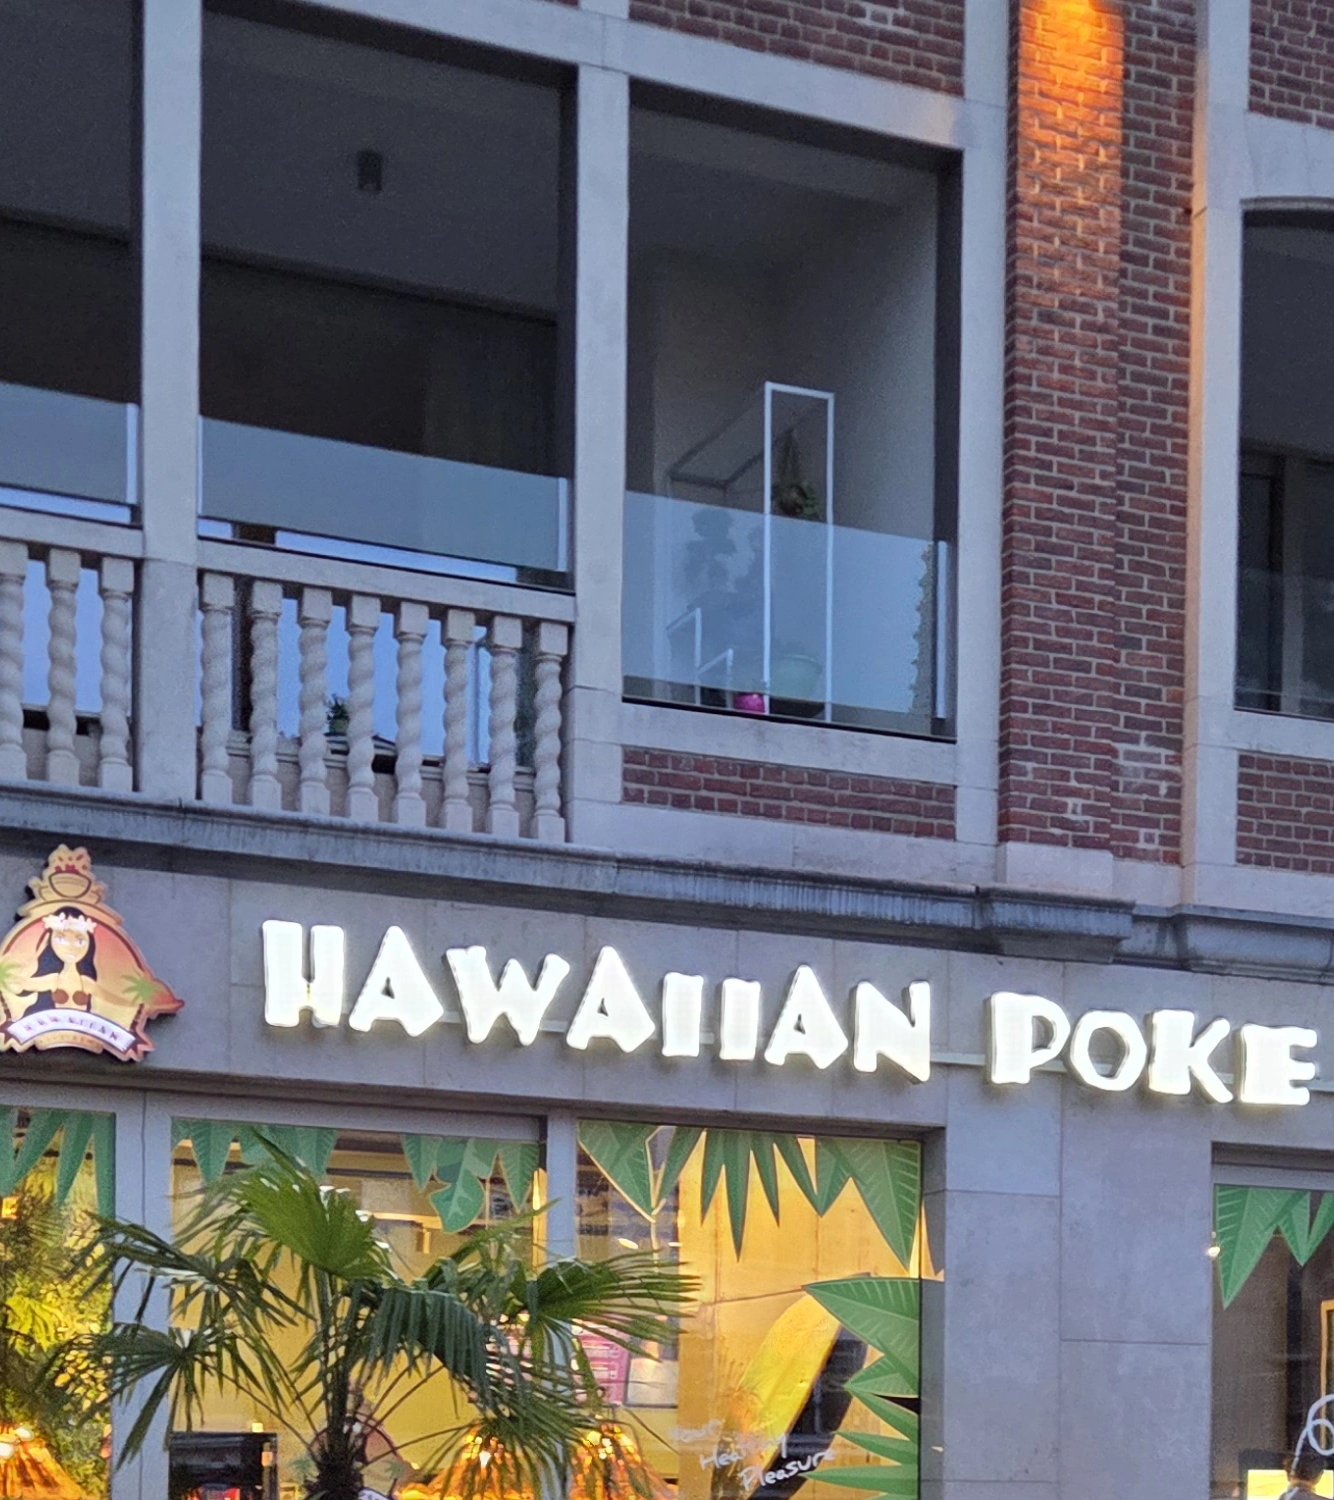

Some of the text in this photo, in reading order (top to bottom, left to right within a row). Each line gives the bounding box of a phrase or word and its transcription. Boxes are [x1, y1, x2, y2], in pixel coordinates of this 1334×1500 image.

[262, 919, 930, 1083] HAWAIIAN
[987, 990, 1320, 1106] POKE
[738, 1448, 836, 1491] Pleasure
